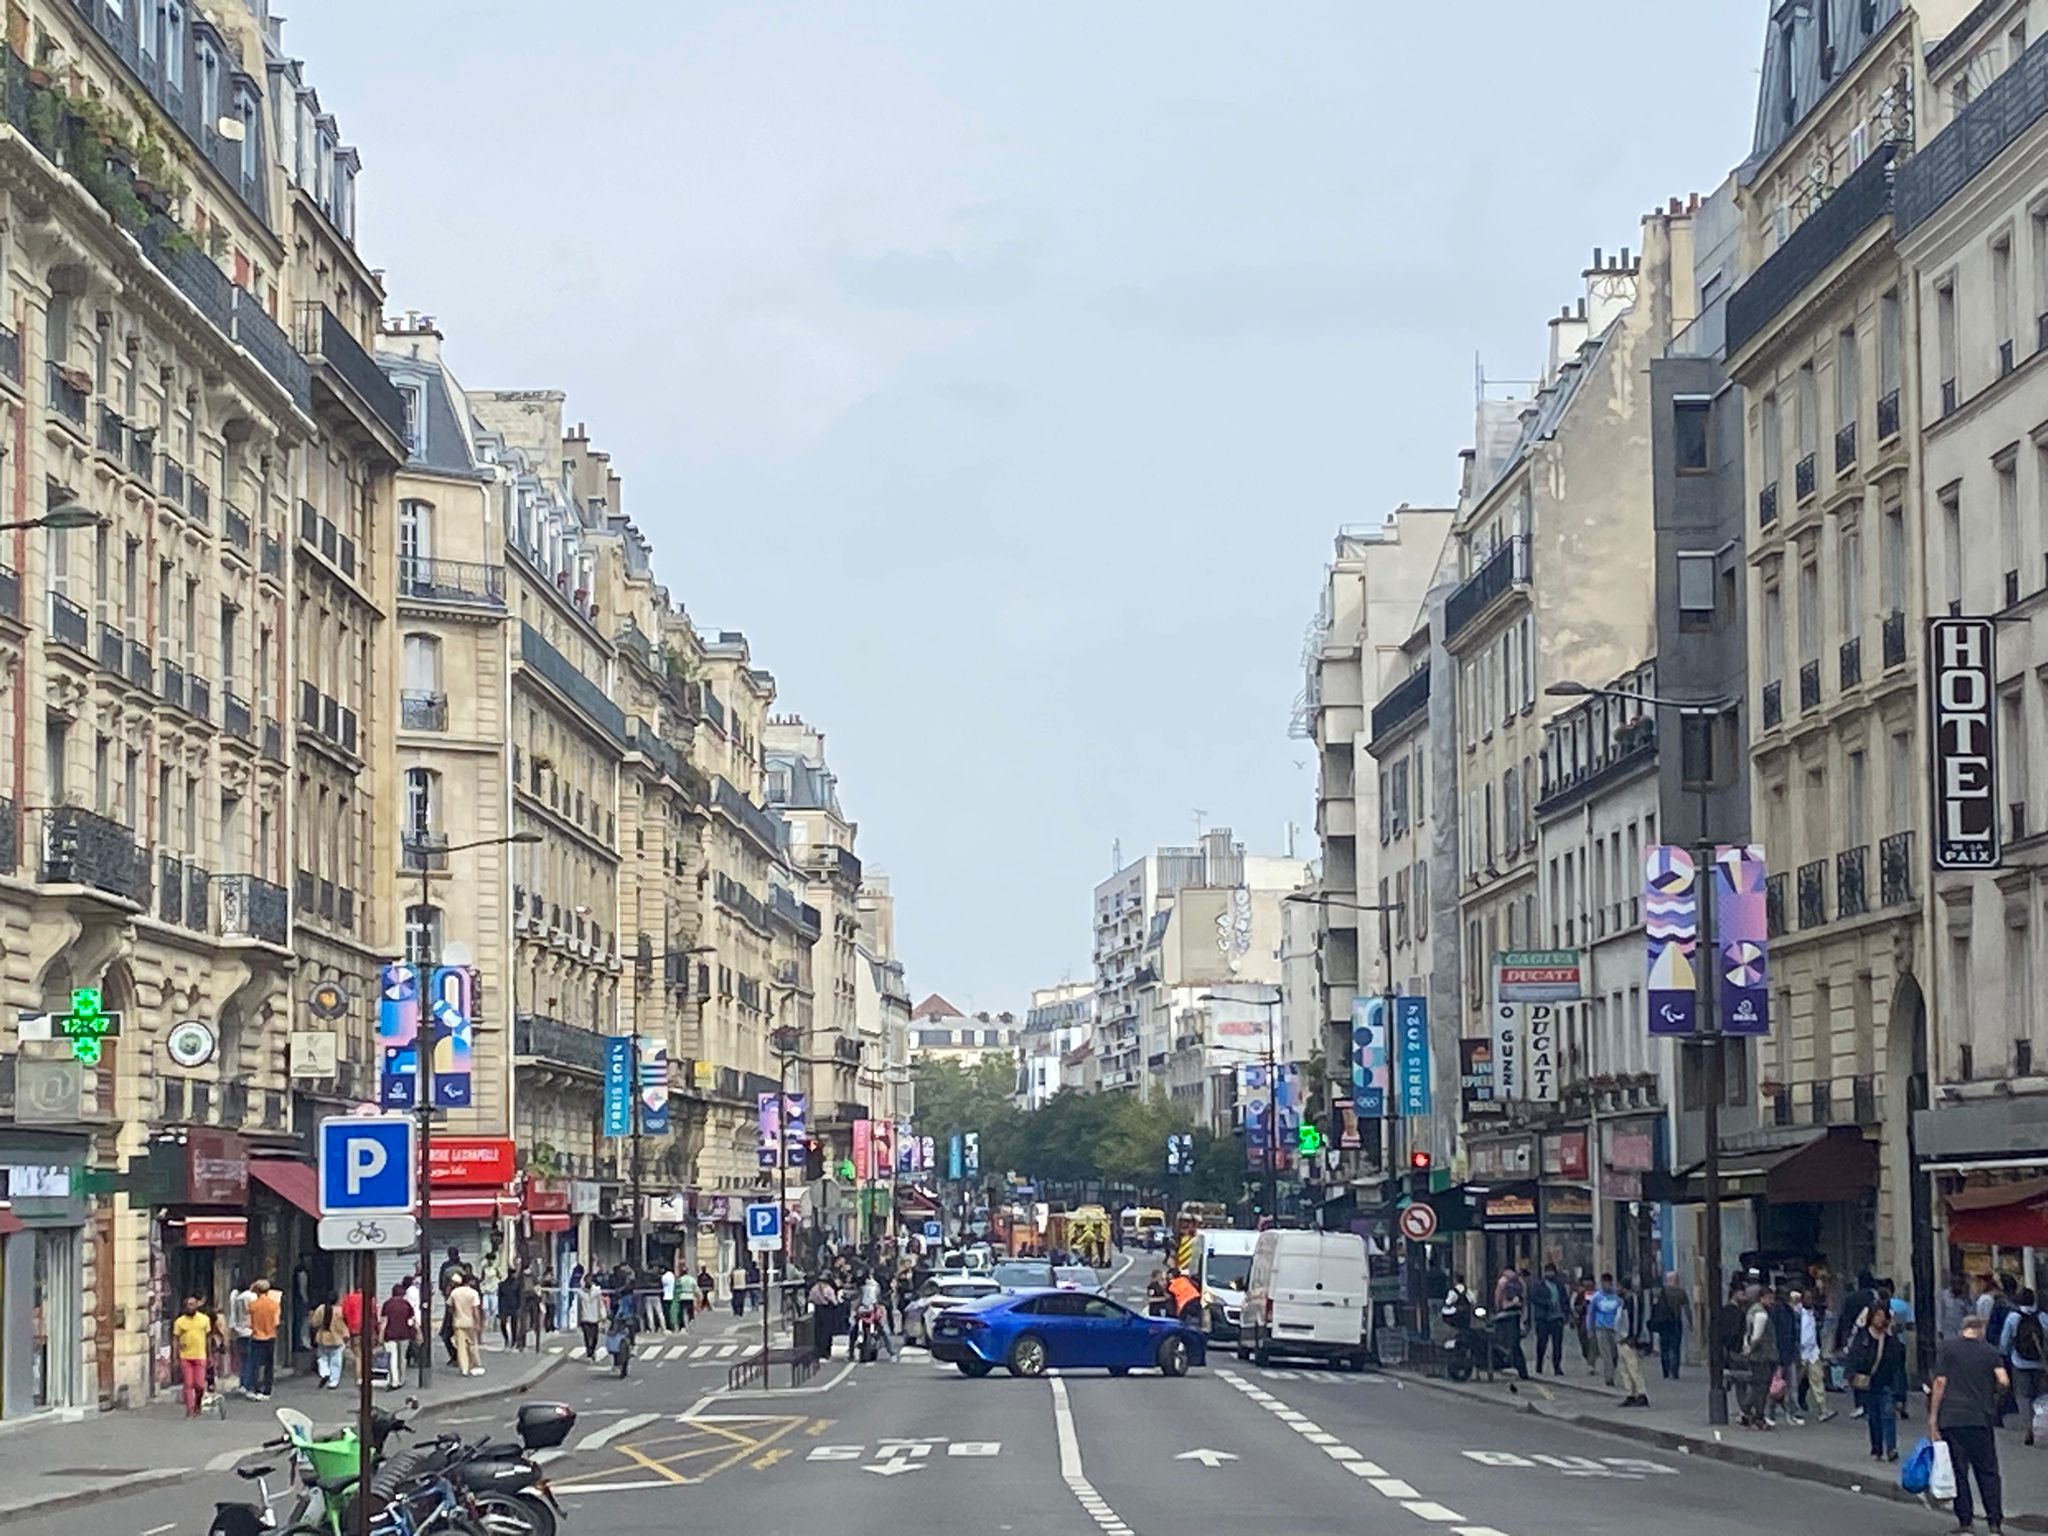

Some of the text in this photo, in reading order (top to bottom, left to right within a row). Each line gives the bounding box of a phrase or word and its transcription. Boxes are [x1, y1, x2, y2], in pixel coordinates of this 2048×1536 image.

[1940, 625, 1990, 841] HOTEL
[1945, 851, 1989, 861] PAIX
[1505, 953, 1576, 965] CAGIVA
[1505, 969, 1577, 982] DUCATI
[61, 1018, 110, 1033] 12:47
[1407, 1005, 1423, 1107] PARIS 2024
[1501, 1029, 1514, 1099] GUZZI
[1531, 1006, 1551, 1099] DUCATI
[611, 1087, 624, 1130] PARIS
[347, 1138, 387, 1195] P
[756, 1211, 772, 1232] P
